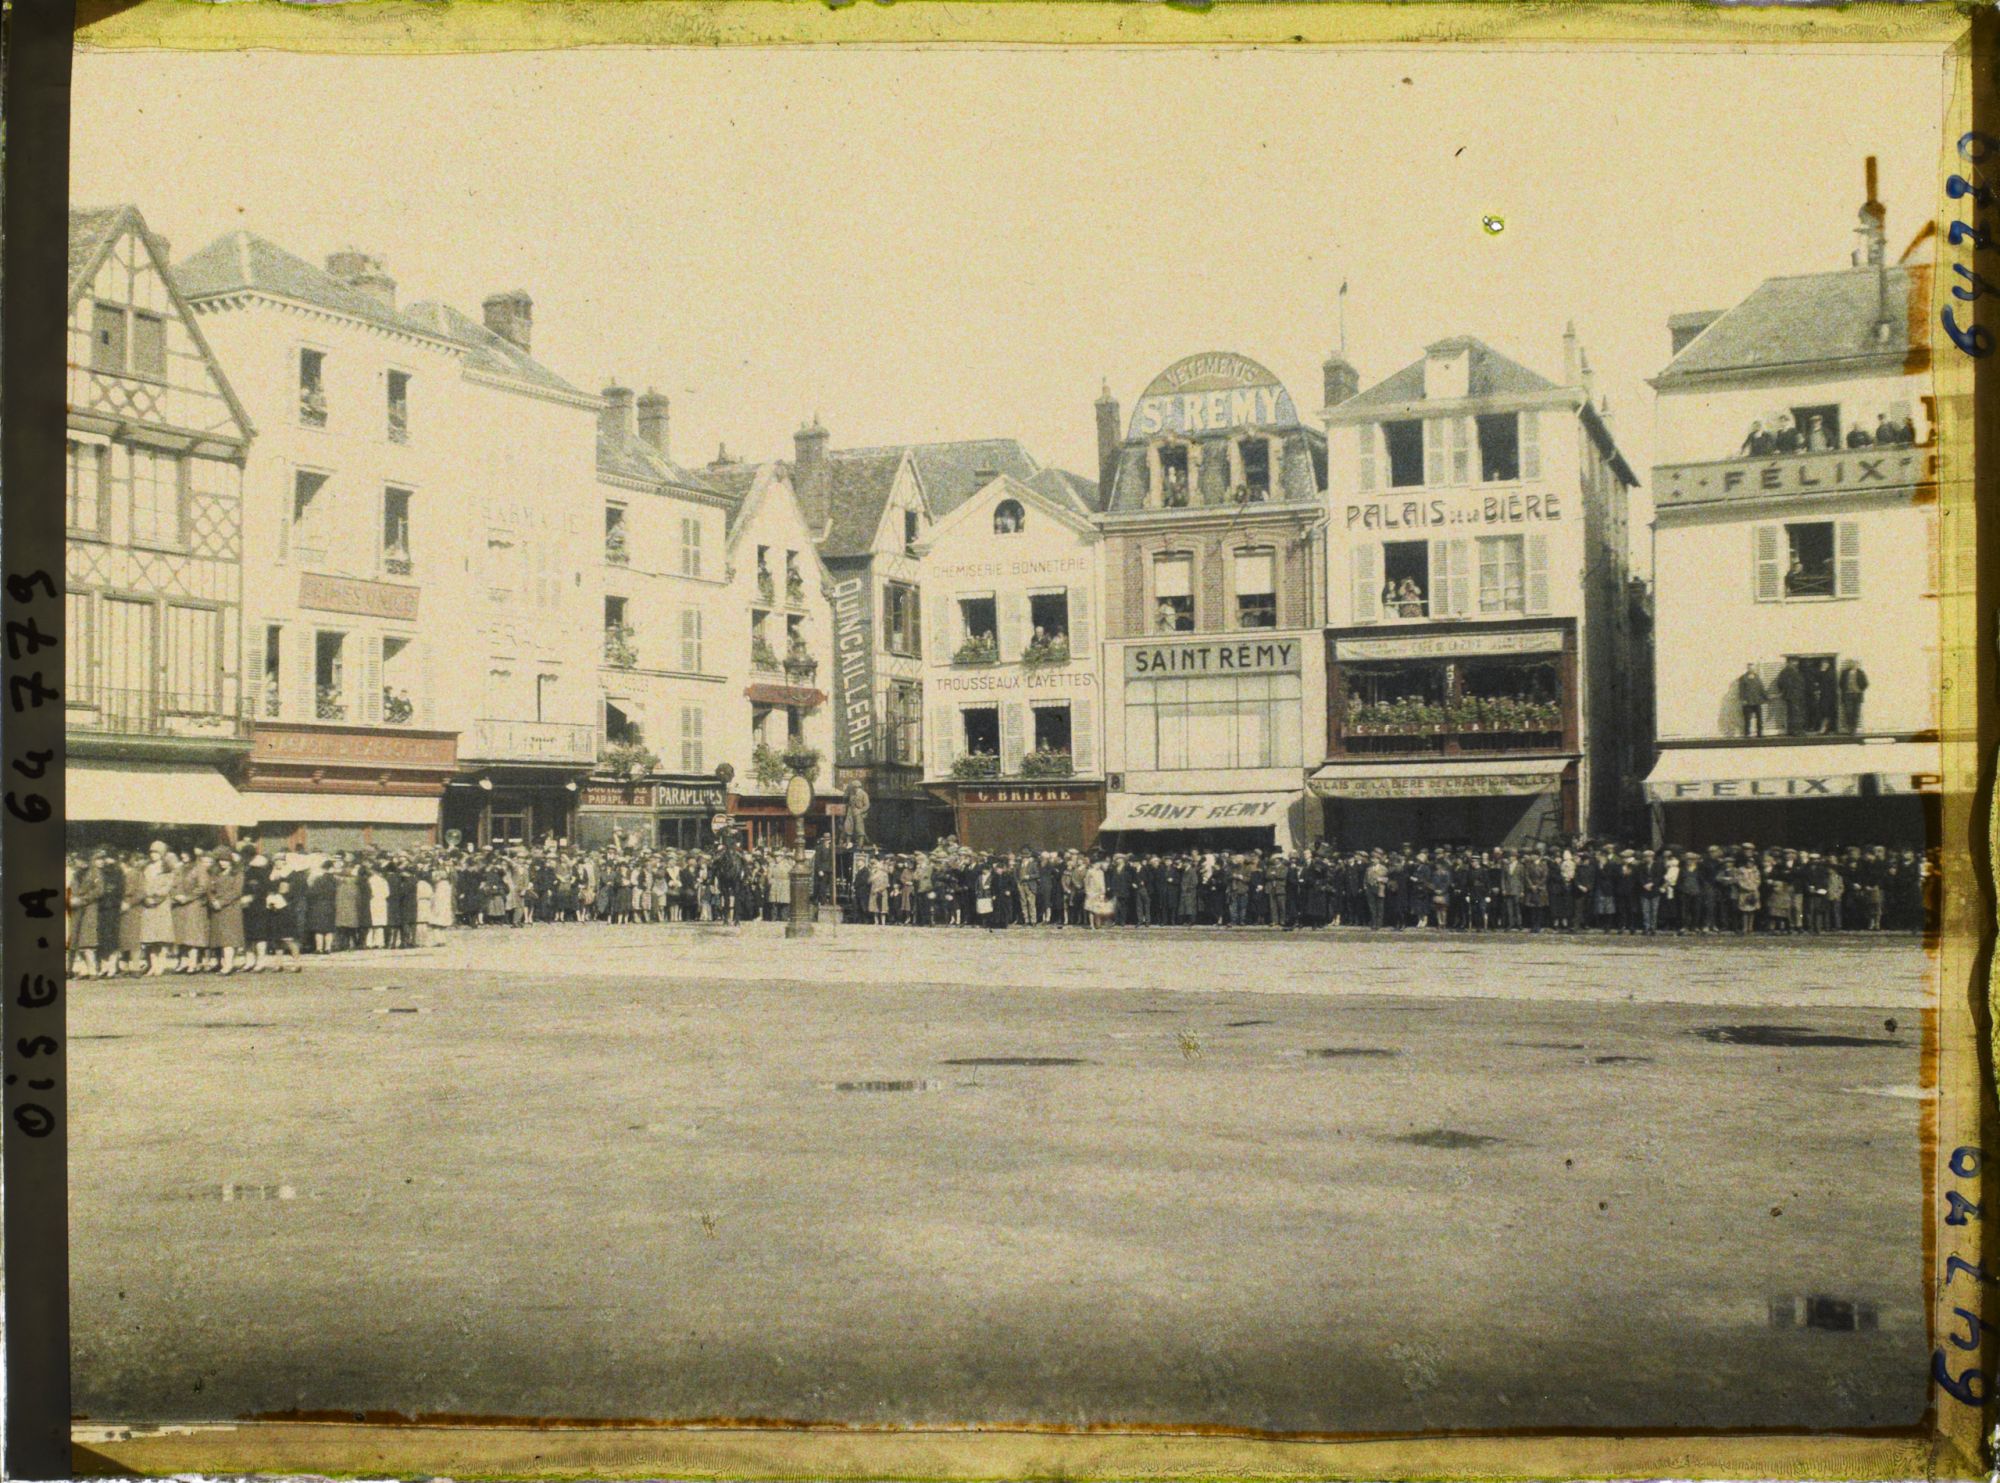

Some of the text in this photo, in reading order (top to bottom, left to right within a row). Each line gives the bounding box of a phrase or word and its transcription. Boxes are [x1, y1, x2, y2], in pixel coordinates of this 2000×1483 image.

[1183, 385, 1286, 432] REMY
[1346, 500, 1446, 528] PALAIS
[932, 557, 1088, 579] CHEMISERIE BONNETERIE
[833, 577, 874, 759] QUINCAILLERIE
[1135, 648, 1211, 673] SAINT
[936, 672, 1092, 691] TROUSSEAUX LAYETTES
[1675, 778, 1831, 796] FELIX
[588, 794, 646, 805] PARAPLES
[1128, 801, 1277, 819] SAINT REMY
